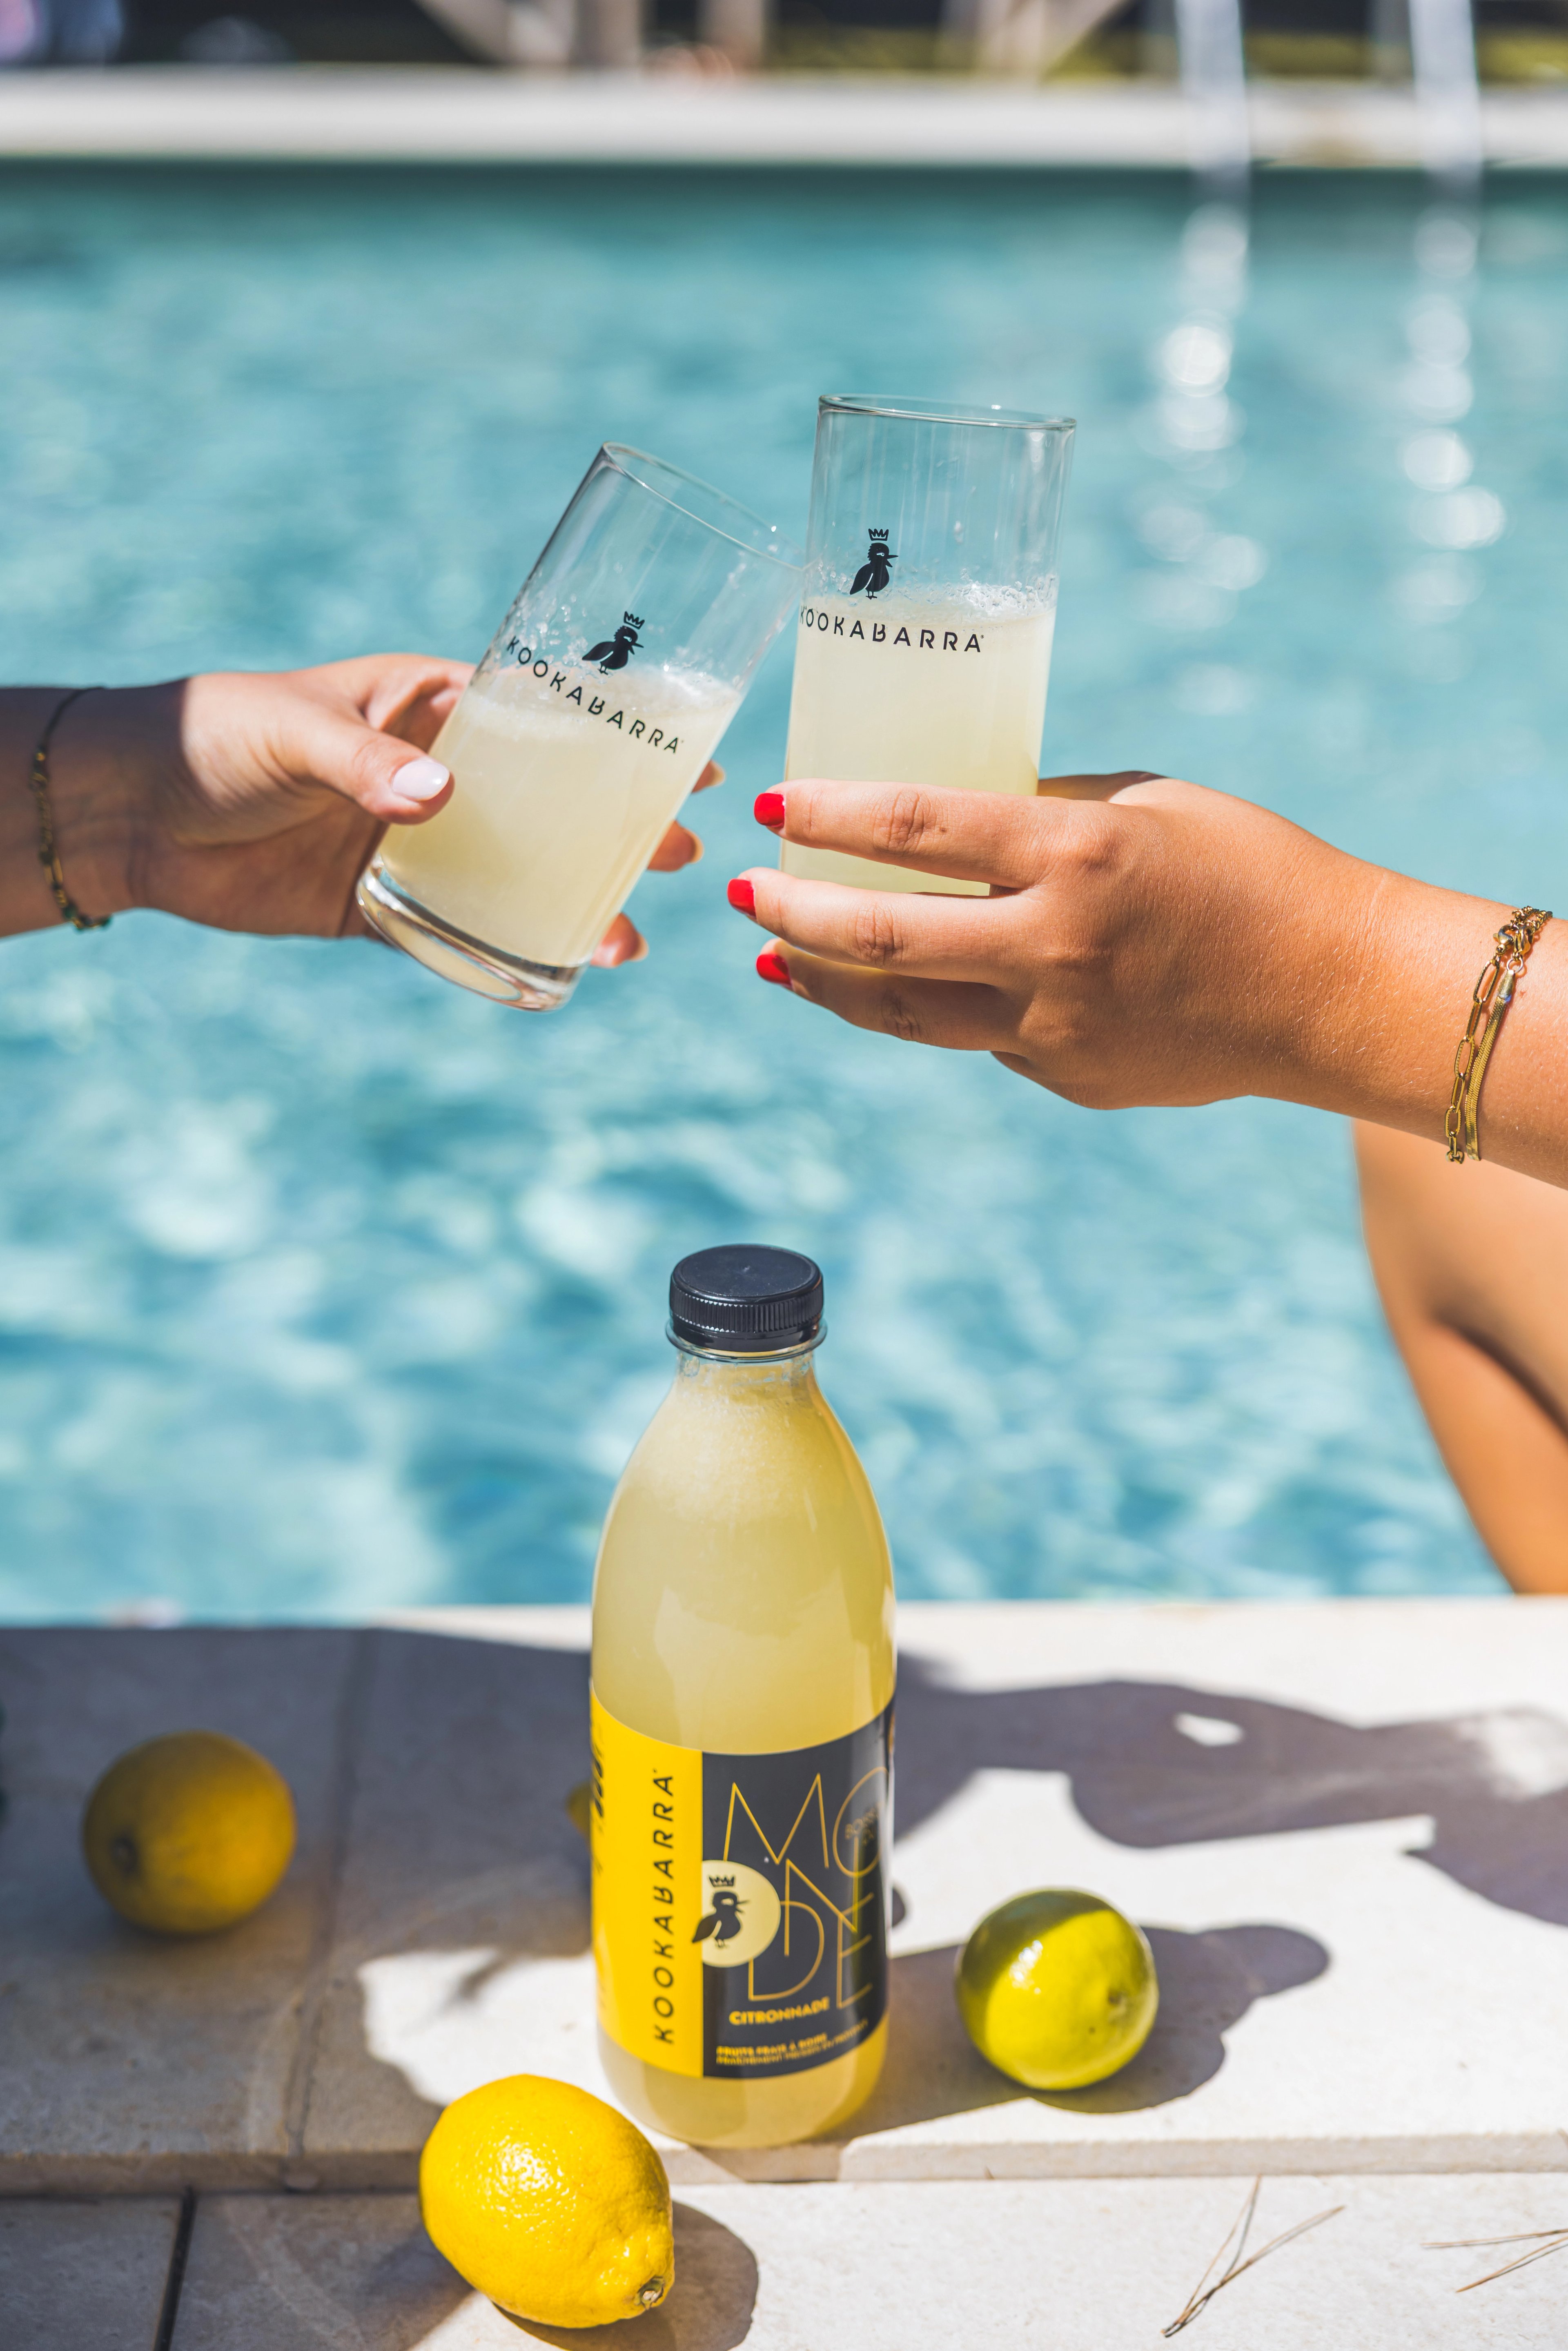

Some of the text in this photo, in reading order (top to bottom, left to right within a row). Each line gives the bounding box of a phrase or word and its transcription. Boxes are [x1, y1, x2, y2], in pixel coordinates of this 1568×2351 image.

[506, 635, 679, 753] KOOKABARRA
[653, 1776, 674, 2044] KOOKABARRA
[729, 1996, 830, 2026] CITRONNADE
